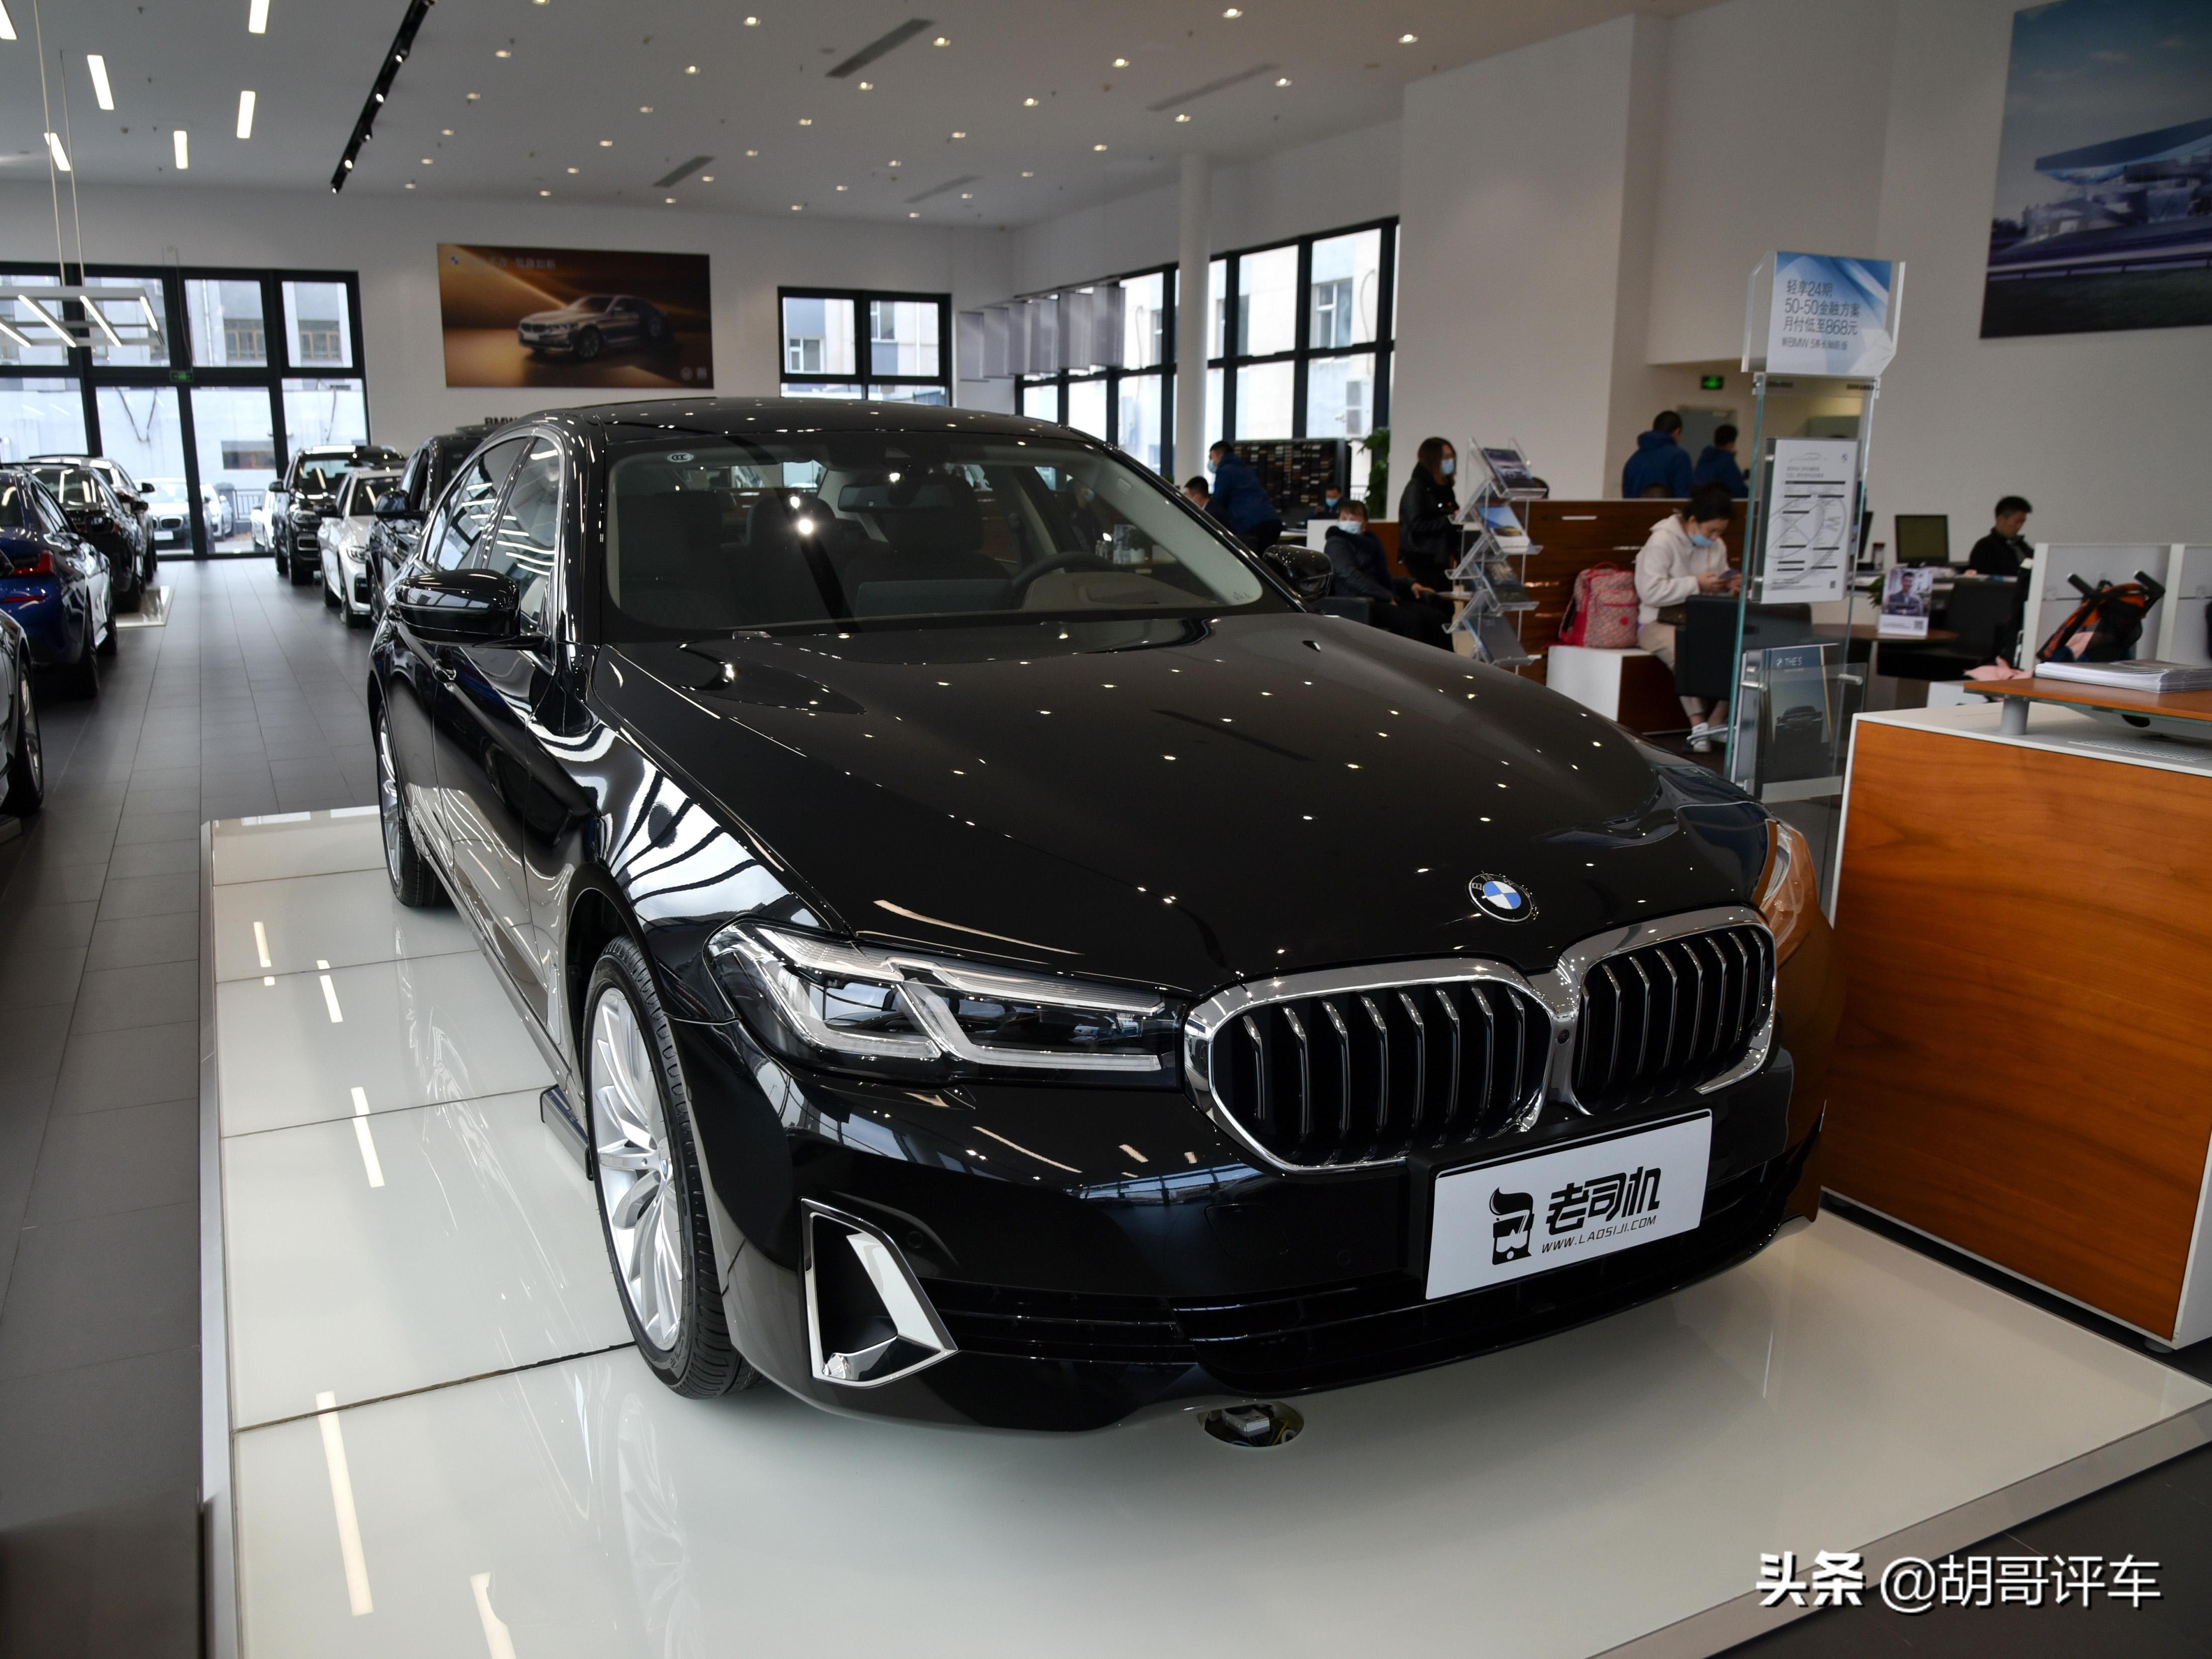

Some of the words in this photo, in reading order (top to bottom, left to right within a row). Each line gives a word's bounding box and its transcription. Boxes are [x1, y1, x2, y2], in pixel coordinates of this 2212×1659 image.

[1786, 279, 1833, 297] 轻享24期
[1785, 298, 1860, 318] 50-50金融方案
[1783, 315, 1859, 335] 月付低至868元
[1471, 874, 1521, 891] BMW
[1545, 1166, 1661, 1235] 老司机
[1541, 1215, 1656, 1253] WWW.LAOSIJI.COM
